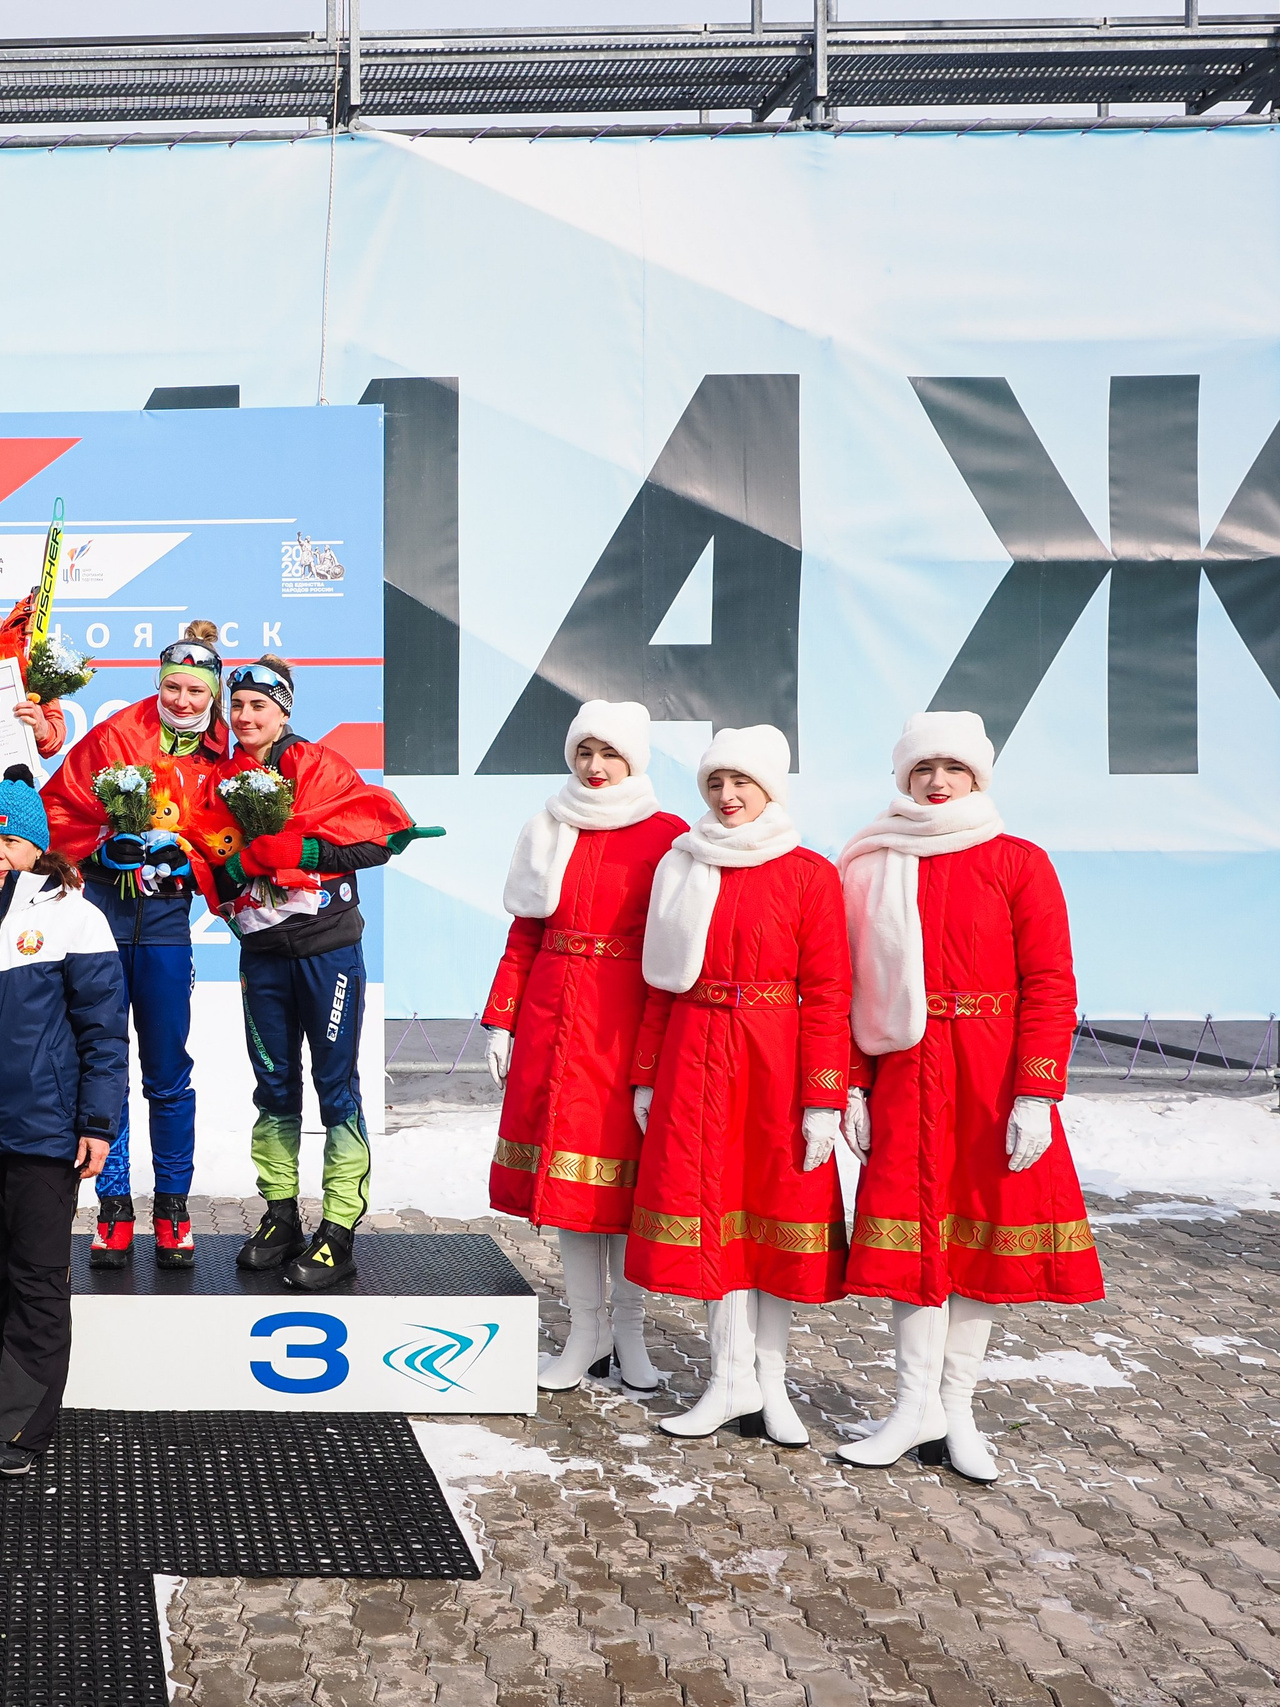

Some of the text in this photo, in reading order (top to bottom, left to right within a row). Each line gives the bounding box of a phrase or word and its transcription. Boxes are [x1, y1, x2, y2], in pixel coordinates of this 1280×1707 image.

[281, 545, 301, 561] 20
[281, 562, 301, 577] 26
[35, 527, 61, 634] FISCHER
[330, 972, 348, 1025] BEEU
[250, 1312, 350, 1394] 3
